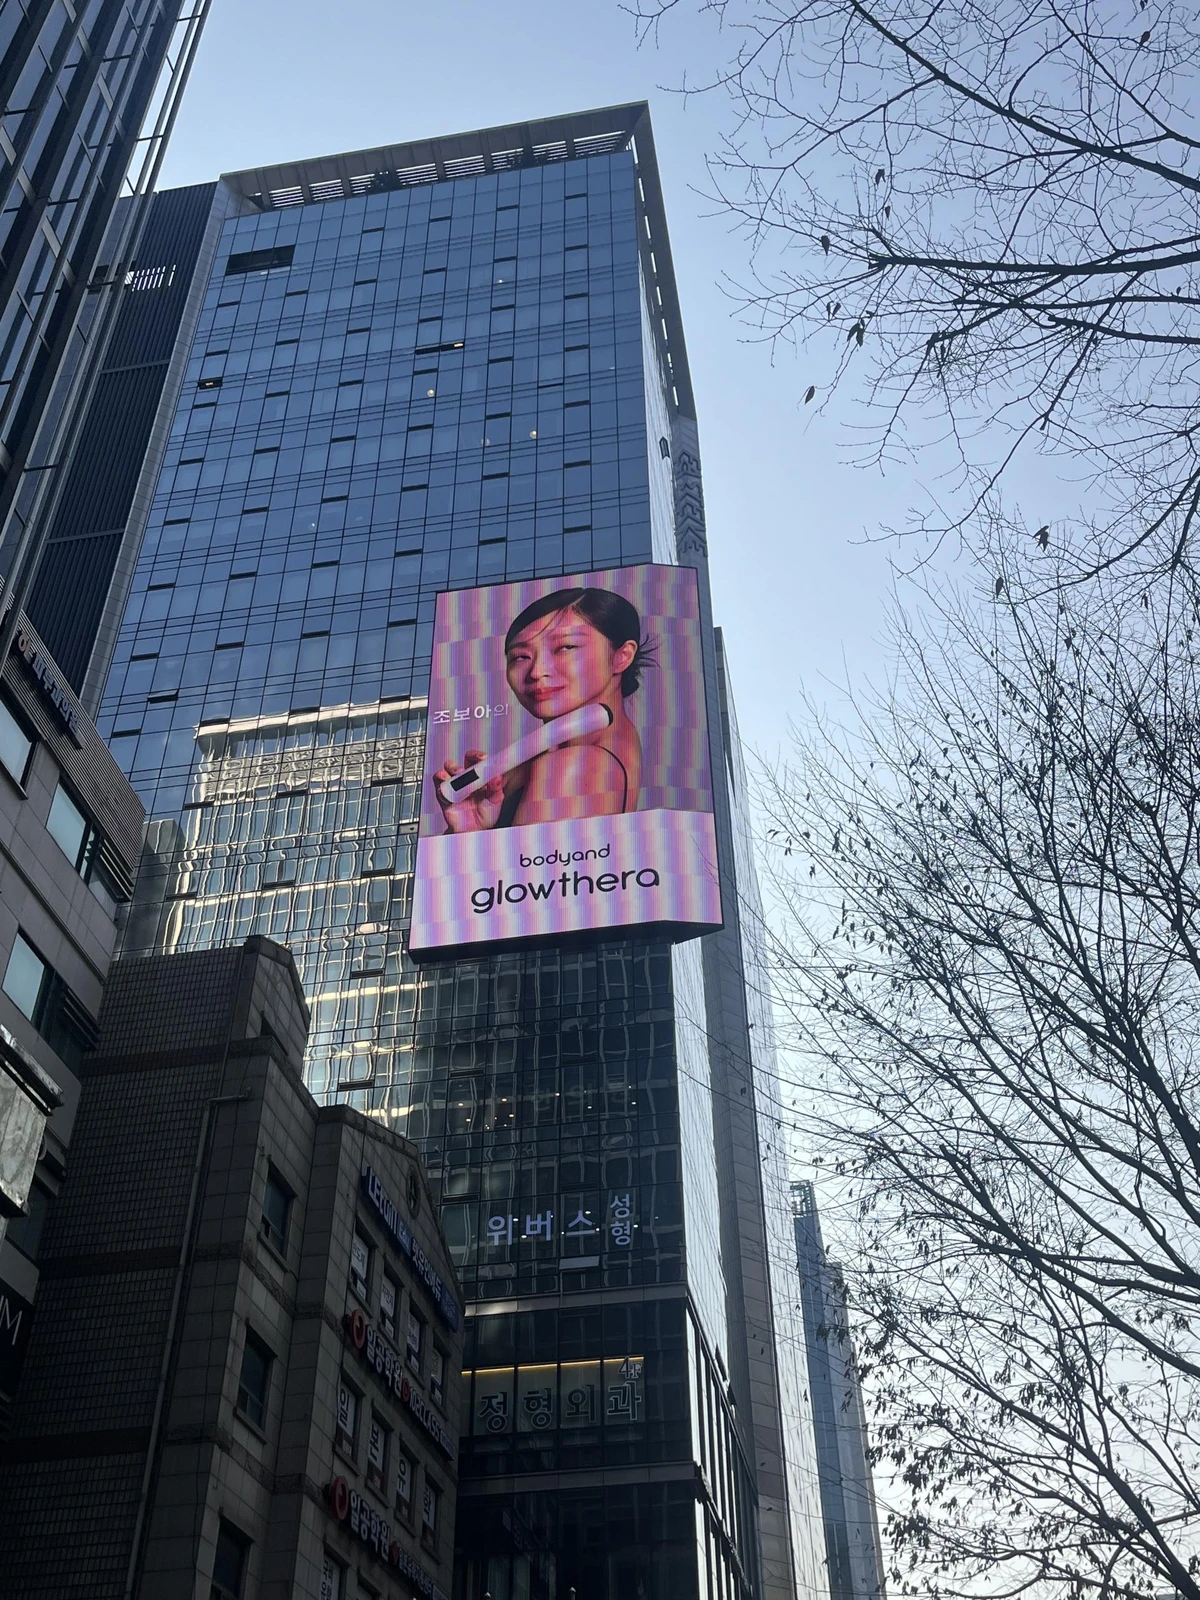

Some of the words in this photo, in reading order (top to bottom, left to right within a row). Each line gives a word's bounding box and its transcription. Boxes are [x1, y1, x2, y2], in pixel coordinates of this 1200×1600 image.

[433, 703, 509, 725] 조보아의
[519, 843, 611, 868] bodyand
[471, 868, 660, 914] glowthera
[486, 1210, 596, 1246] 위버스
[609, 1193, 632, 1246] 성형
[366, 1325, 403, 1399] 일공학원
[618, 1355, 642, 1380] 4F
[477, 1380, 642, 1434] 정형외과
[350, 1489, 390, 1562] 일공학원
